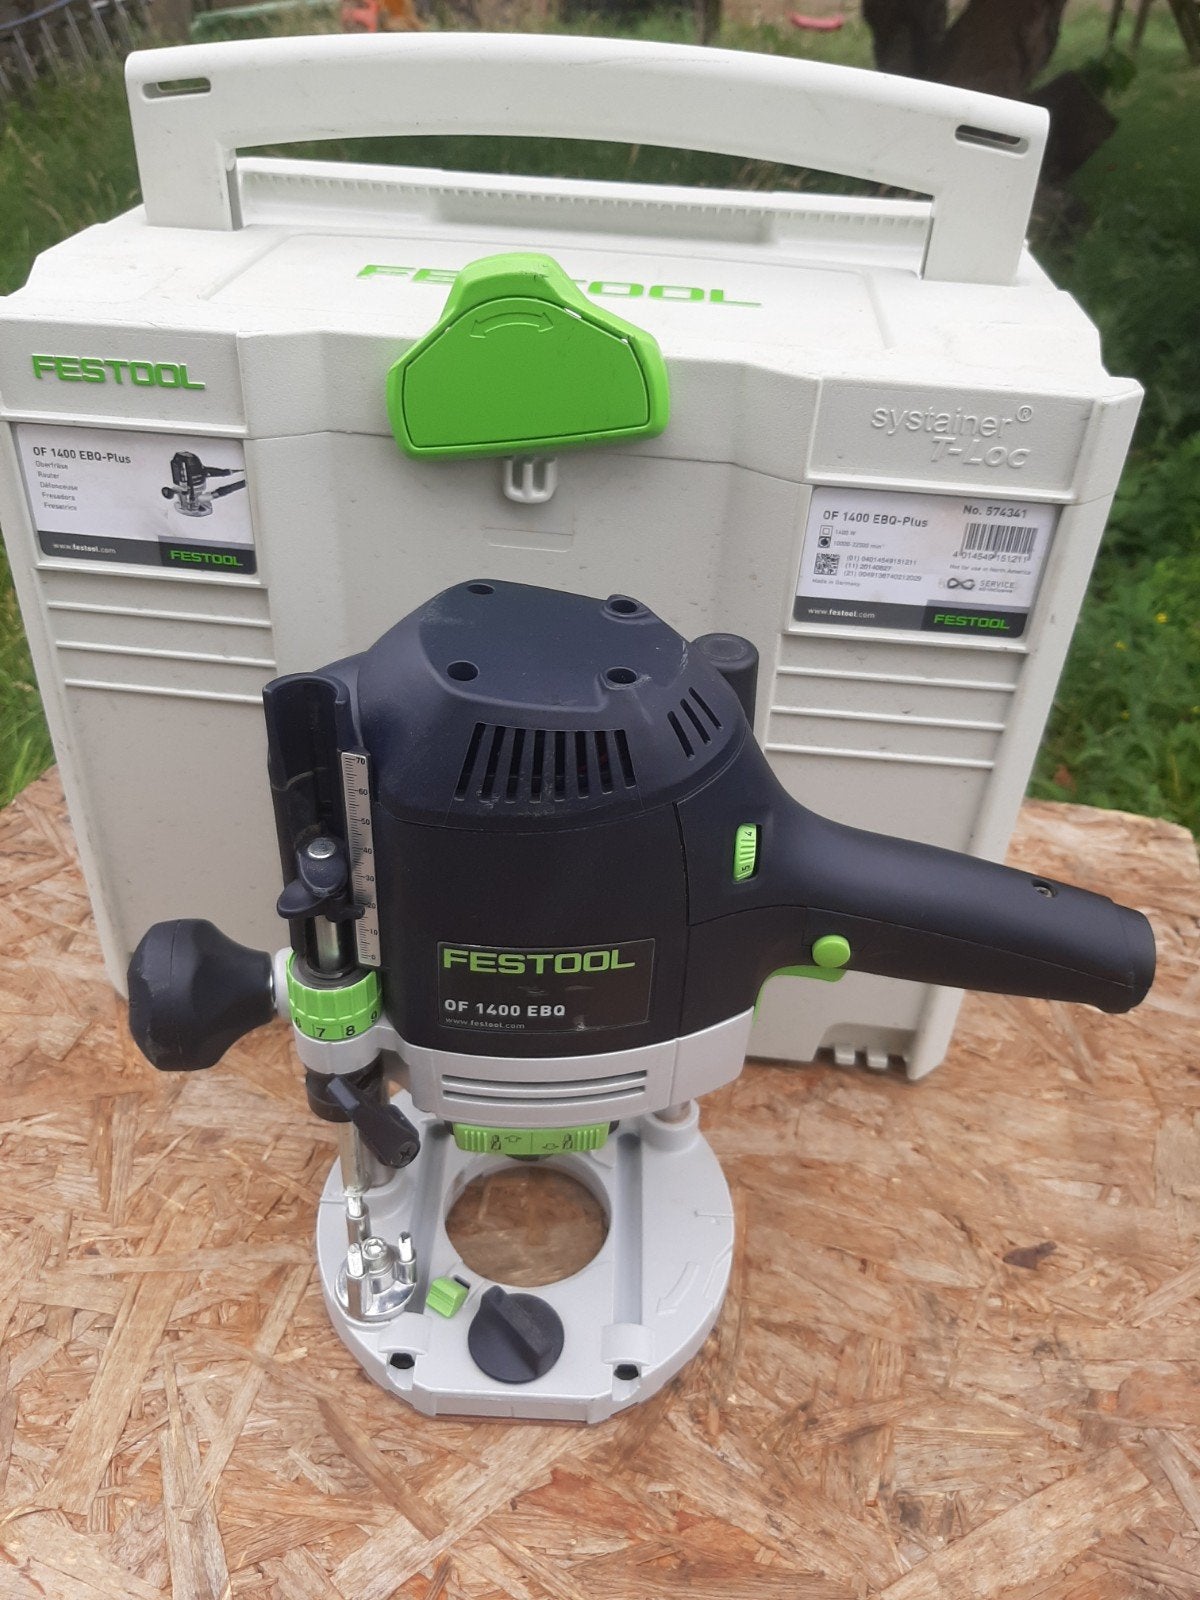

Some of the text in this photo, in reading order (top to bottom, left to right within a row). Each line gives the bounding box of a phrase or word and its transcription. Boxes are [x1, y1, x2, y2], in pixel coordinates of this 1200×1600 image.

[356, 264, 762, 306] FEOOL
[32, 353, 206, 390] FESTOOL
[33, 446, 132, 464] OF 1400 EBQ-Plus
[823, 510, 929, 528] OF 1400 EBQ-Plus
[963, 504, 1027, 519] No. 574341
[170, 549, 244, 567] FESTOOL
[807, 607, 876, 619] www.festool.com
[933, 614, 1010, 630] FESTOOL
[356, 757, 366, 765] 70
[359, 788, 368, 796] 60
[361, 818, 371, 826] 50
[443, 948, 636, 974] FESTOOL
[444, 999, 566, 1017] OF 1400 EBQ
[315, 1027, 326, 1038] 7
[345, 1025, 356, 1037] 8
[445, 1017, 526, 1030] www.festool.com
